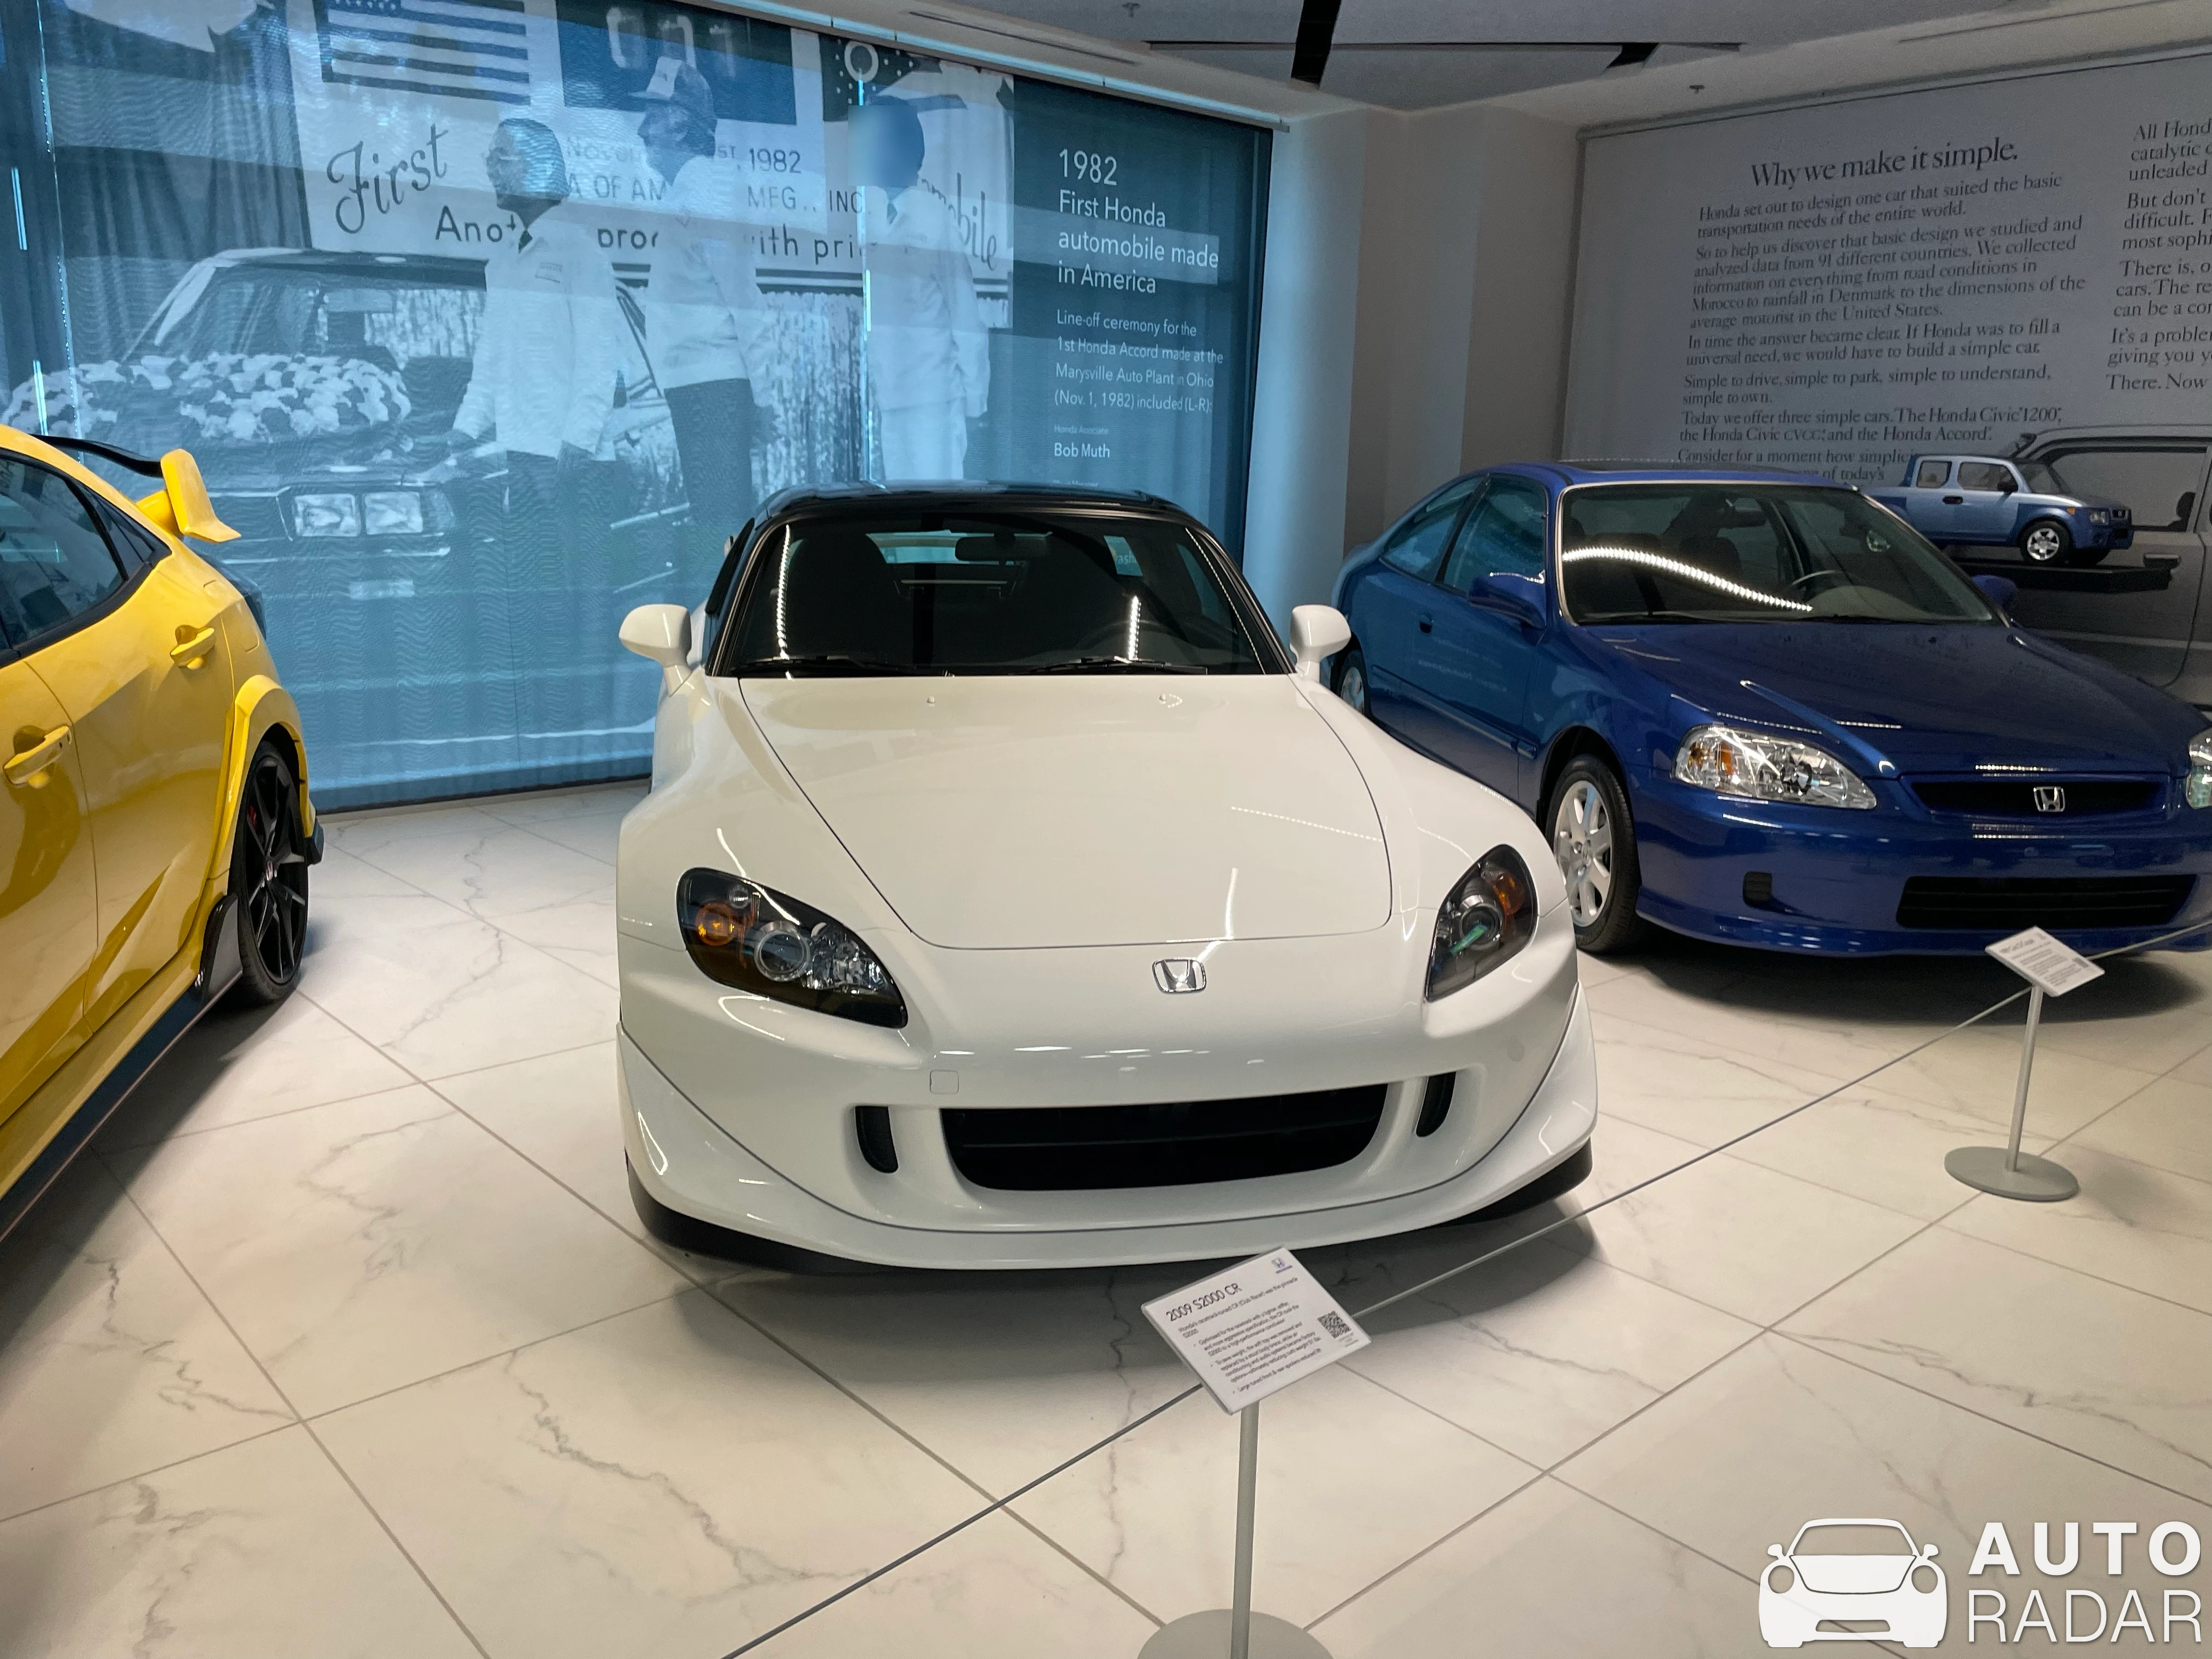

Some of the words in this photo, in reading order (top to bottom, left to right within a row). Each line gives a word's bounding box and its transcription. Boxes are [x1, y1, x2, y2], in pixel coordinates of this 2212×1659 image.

[2133, 123, 2157, 141] All
[2164, 118, 2212, 138] Hond
[749, 147, 802, 174] 1982
[1752, 162, 1801, 190] Why
[1804, 164, 1836, 182] we
[1841, 150, 1906, 177] make
[1911, 145, 1929, 170] it
[1931, 137, 2018, 171] simple.
[2131, 140, 2201, 162] catalytic
[326, 123, 449, 234] First
[1059, 148, 1118, 186] 1982
[2129, 159, 2208, 181] unleaded
[594, 174, 622, 199] OF
[1700, 204, 1740, 221] Honda
[1743, 204, 1762, 217] set
[1765, 201, 1788, 214] out
[1791, 200, 1804, 212] to
[1808, 194, 1852, 211] design
[1856, 193, 1881, 205] one
[1886, 190, 1908, 202] car
[1911, 185, 1939, 199] that
[1943, 178, 1989, 196] suited
[1994, 176, 2019, 192] the
[2024, 172, 2062, 189] basic
[2127, 192, 2157, 209] But
[2163, 188, 2206, 207] don't
[1059, 188, 1099, 218] First
[1105, 196, 1166, 228] Honda
[1697, 220, 1784, 240] transportation
[1788, 213, 1827, 230] needs
[1831, 210, 1846, 225] of
[1848, 209, 1871, 224] the
[1875, 205, 1916, 222] entire
[1921, 200, 1966, 217] world.
[2124, 211, 2194, 229] difficult.
[743, 223, 799, 256] ith
[1058, 230, 1165, 261] automobile
[1171, 243, 1218, 268] made
[1696, 245, 1712, 260] So
[1716, 245, 1728, 258] to
[1730, 241, 1759, 259] help
[1763, 243, 1777, 255] us
[1781, 238, 1837, 254] discover
[1841, 233, 1868, 247] that
[1872, 230, 1906, 246] basic
[1910, 227, 1959, 244] design
[1963, 225, 1985, 238] we
[1990, 216, 2049, 236] studied
[2053, 213, 2084, 231] and
[2122, 236, 2162, 250] most
[1694, 259, 1749, 278] analyzed
[1752, 258, 1780, 273] data
[1783, 256, 1815, 271] from
[1836, 250, 1897, 267] different
[1900, 244, 1972, 262] countries.
[1977, 239, 2001, 255] We
[2006, 235, 2076, 255] collected
[2119, 258, 2172, 277] There
[1058, 259, 1075, 284] in
[1080, 263, 1156, 294] America
[1768, 278, 1786, 289] on
[1867, 267, 1899, 282] from
[1903, 263, 1936, 280] road
[1939, 259, 2018, 278] conditions
[2022, 257, 2038, 273] in
[1812, 292, 1824, 304] in
[1830, 284, 1895, 303] Denmark
[1900, 288, 1915, 298] to
[1920, 283, 1943, 297] the
[1947, 279, 2034, 297] dimensions
[2039, 275, 2057, 291] of
[2060, 275, 2086, 291] the
[2116, 284, 2151, 297] cars.
[2154, 278, 2190, 295] The
[1742, 312, 1794, 326] motorist
[1816, 308, 1837, 322] the
[1843, 303, 1891, 321] United
[1895, 303, 1943, 318] States.
[2113, 305, 2141, 317] can
[2147, 300, 2168, 316] be
[2173, 304, 2182, 315] a
[1057, 309, 1101, 328] Line-off
[1103, 317, 1160, 337] ceremony
[1164, 318, 1180, 335] for
[1181, 321, 1197, 336] the
[1689, 335, 1701, 349] In
[1737, 332, 1757, 347] the
[1759, 334, 1807, 346] answer
[1810, 329, 1864, 343] became
[1923, 322, 1972, 339] Honda
[1976, 324, 2005, 336] was
[2009, 324, 2024, 335] to
[2029, 318, 2049, 335] fill
[2112, 328, 2135, 343] It's
[2140, 331, 2148, 343] a
[1058, 335, 1075, 352] 1st
[1078, 337, 1116, 355] Honda
[1119, 341, 1158, 359] Accord
[1161, 346, 1190, 362] made
[1193, 350, 1205, 363] at
[1207, 349, 1223, 364] the
[1686, 350, 1741, 366] universal
[1782, 352, 1801, 362] we
[1805, 346, 1847, 362] would
[1851, 346, 1883, 359] have
[1887, 347, 1902, 358] to
[1907, 342, 1944, 357] build
[1961, 339, 2012, 358] simple
[2107, 347, 2160, 368] giving
[2164, 349, 2194, 367] you
[1056, 363, 1113, 383] Marysville
[1116, 367, 1143, 383] Auto
[1146, 369, 1175, 385] Plant
[1186, 372, 1214, 388] Ohio
[1684, 373, 1728, 391] Simple
[1784, 370, 1829, 389] simple
[1832, 373, 1846, 384] to
[1888, 367, 1937, 386] simple
[1942, 370, 1956, 381] to
[2106, 374, 2162, 390] There.
[2166, 373, 2209, 390] Now
[1054, 389, 1086, 407] (Nov.
[1088, 391, 1097, 408] 1,
[1101, 392, 1135, 410] 1982)
[1137, 394, 1183, 411] included
[1683, 390, 1724, 408] simple
[1681, 410, 1718, 428] Today
[1723, 414, 1741, 424] we
[1743, 409, 1776, 424] offer
[1778, 409, 1811, 424] three
[1815, 409, 1861, 427] simple
[1929, 408, 1976, 422] Honda
[1680, 428, 1699, 441] the
[1702, 427, 1742, 441] Honda
[1828, 427, 1853, 441] and
[1858, 427, 1878, 441] the
[1884, 426, 1932, 441] Honda
[1054, 442, 1079, 458] Bob
[1081, 442, 1110, 458] Muth
[1678, 448, 1734, 462] Consider
[1736, 448, 1754, 462] for
[1767, 452, 1821, 462] moment
[1826, 449, 1855, 462] how
[1166, 1303, 1193, 1322] 2009
[1192, 1290, 1226, 1310] S2000
[1224, 1283, 1243, 1296] CR
